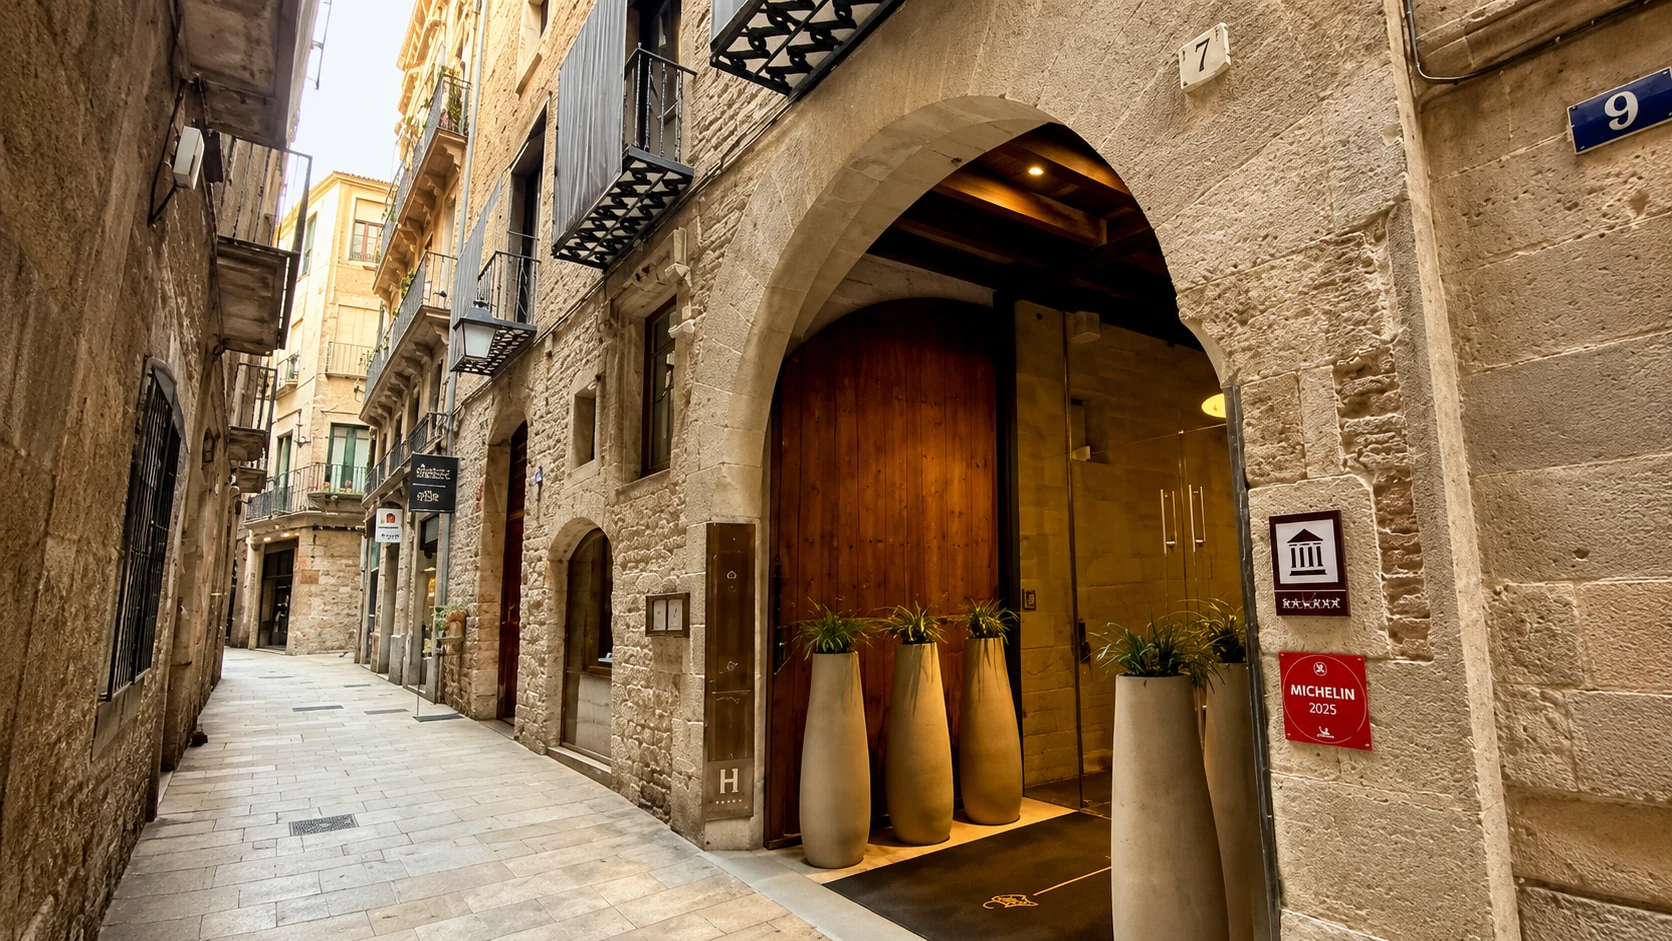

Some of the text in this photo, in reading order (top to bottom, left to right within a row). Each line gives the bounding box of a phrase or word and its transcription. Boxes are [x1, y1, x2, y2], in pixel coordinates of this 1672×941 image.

[1195, 37, 1210, 72] 7
[1604, 91, 1639, 131] 9
[1290, 684, 1355, 701] MICHELIN
[1308, 702, 1337, 715] 2025
[720, 768, 739, 794] H
